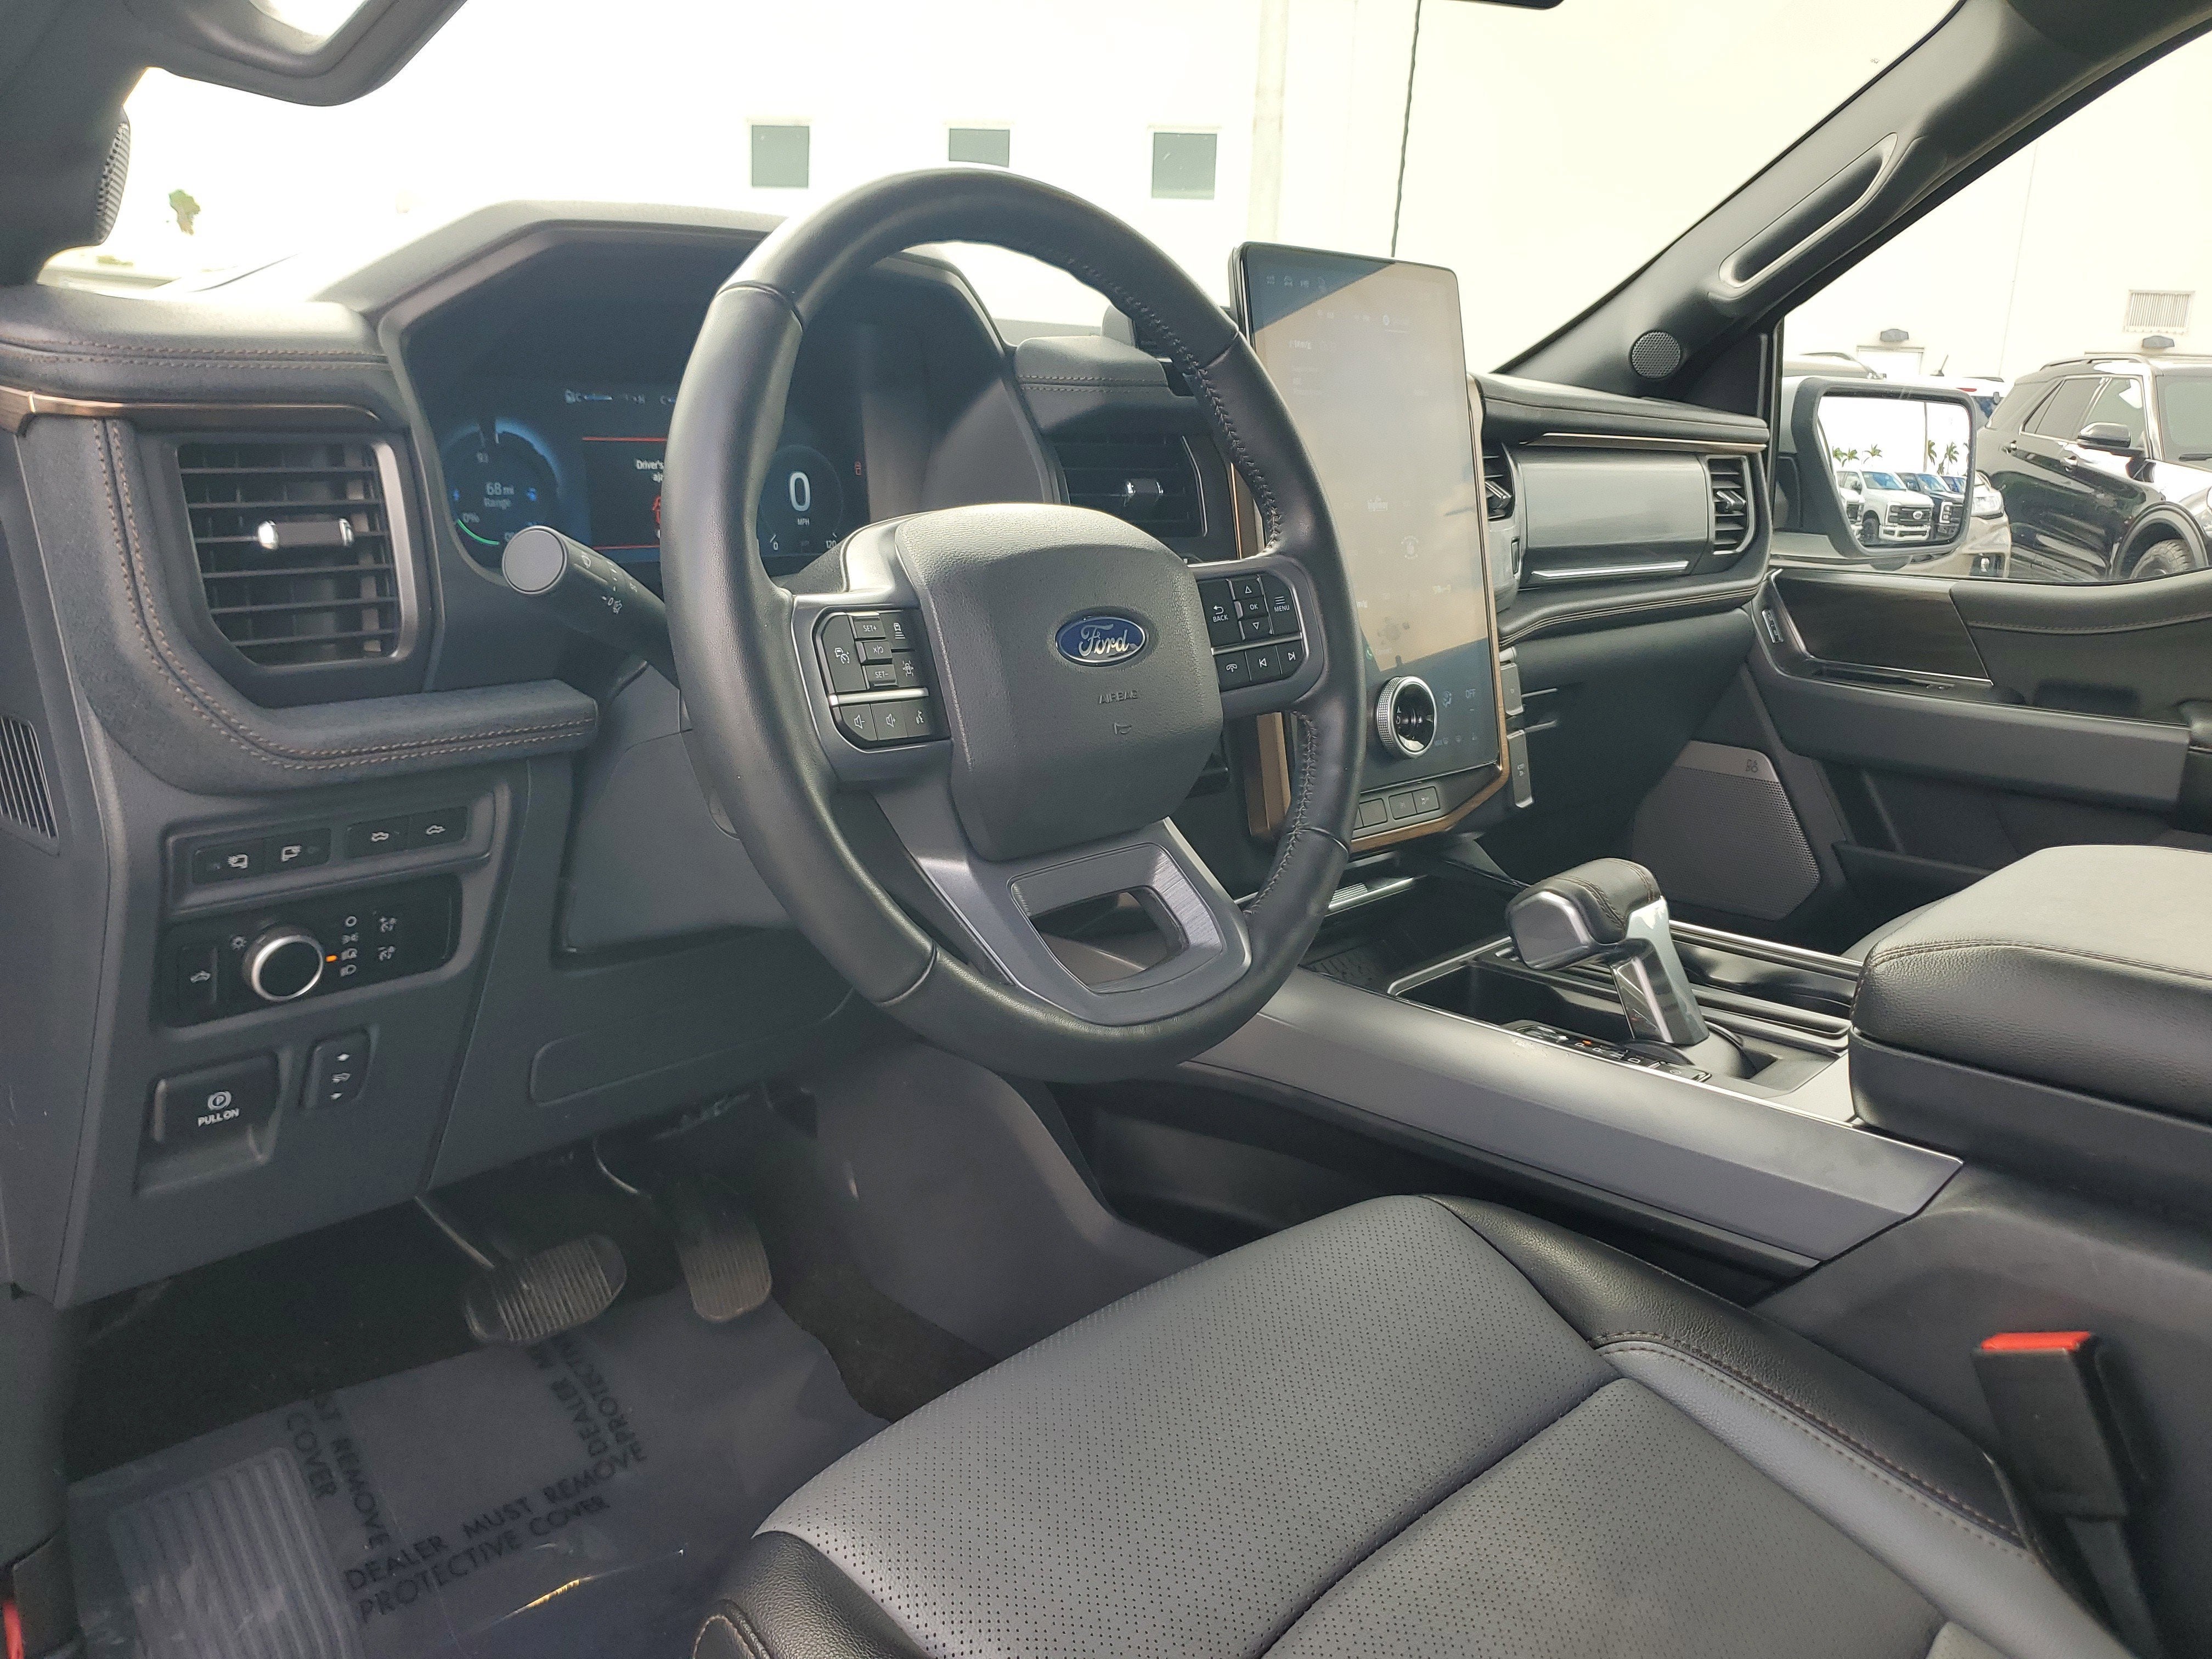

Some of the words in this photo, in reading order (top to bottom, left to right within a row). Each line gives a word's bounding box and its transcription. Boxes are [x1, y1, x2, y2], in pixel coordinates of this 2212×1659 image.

[789, 471, 811, 512] 0
[772, 541, 779, 551] 0
[1212, 615, 1228, 623] BACK
[1274, 605, 1290, 613] MENU
[862, 624, 878, 633] SET+
[1078, 623, 1129, 657] Ford
[1098, 690, 1138, 704] AIRBAG
[198, 1113, 223, 1127] PULL
[224, 1108, 240, 1120] ON
[286, 1412, 338, 1500] COVER
[331, 1437, 391, 1550] REMOVE
[344, 1535, 449, 1591] DEALER
[462, 1497, 534, 1539] MUST
[543, 1441, 647, 1504] REMOVE
[358, 1529, 522, 1624] PROTECTIVE
[528, 1494, 611, 1537] COVER
